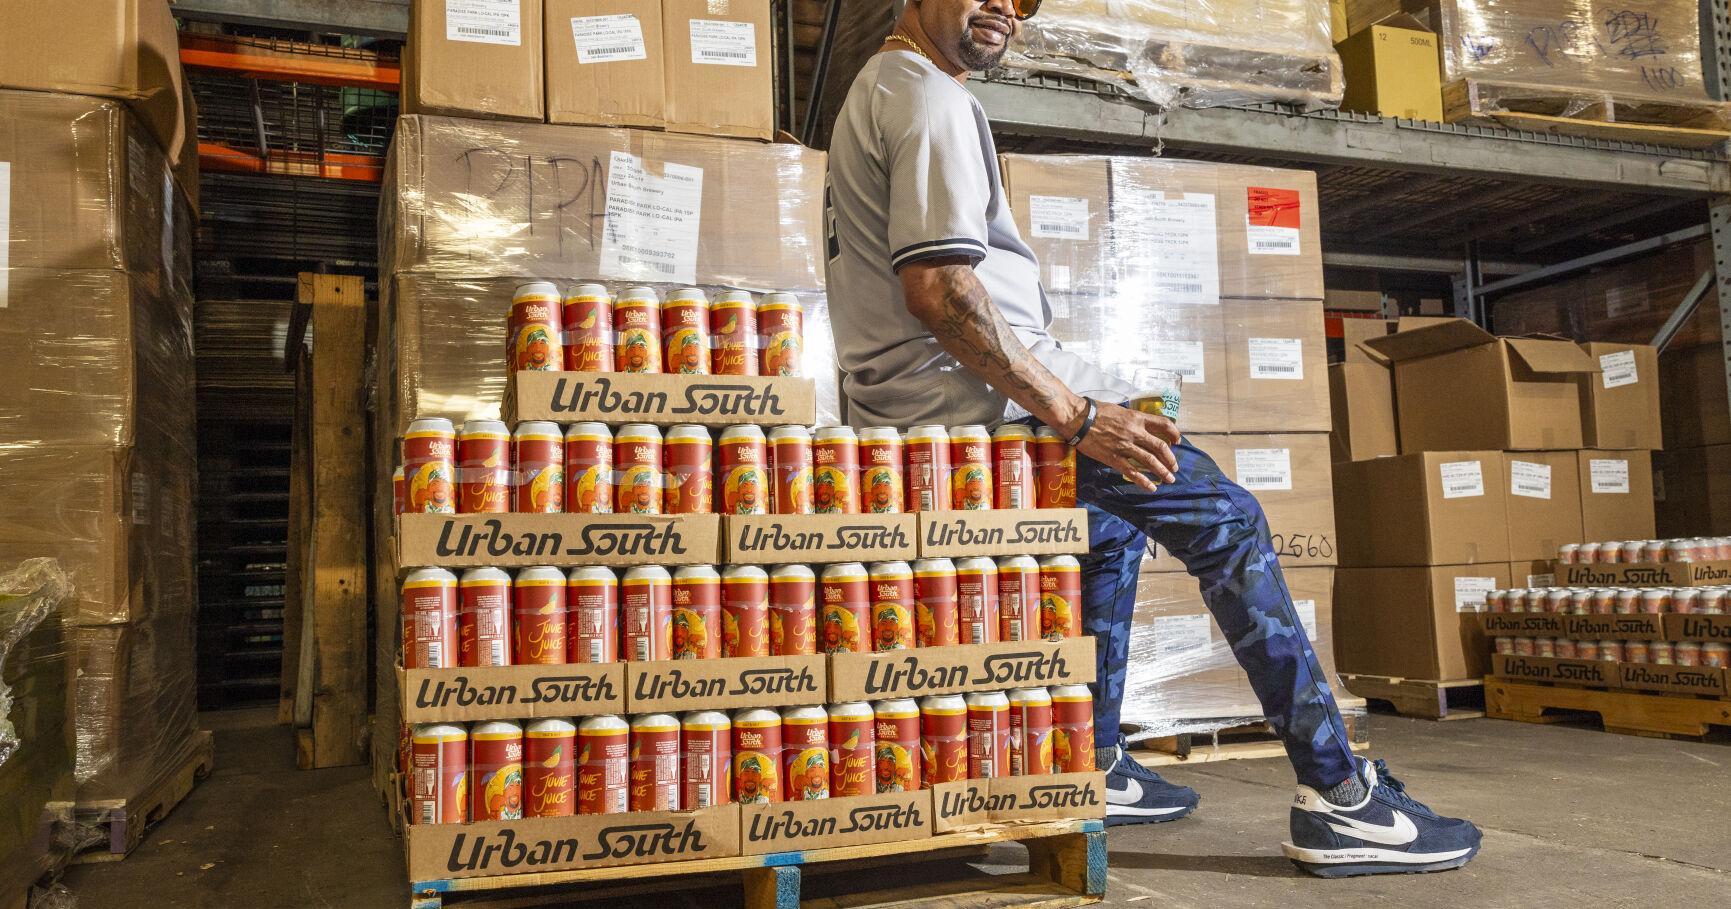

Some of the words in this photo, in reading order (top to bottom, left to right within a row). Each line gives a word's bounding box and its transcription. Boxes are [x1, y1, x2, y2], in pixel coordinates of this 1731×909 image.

[1378, 33, 1387, 41] 12
[1410, 37, 1433, 48] 500ML
[551, 378, 667, 414] Urban
[671, 383, 785, 416] South
[436, 519, 563, 557] Urban
[566, 520, 687, 555] South
[738, 523, 825, 552] Urban
[827, 522, 910, 550] South
[926, 518, 1003, 547] Urban
[1006, 517, 1082, 543] South
[1271, 534, 1332, 558] 2560
[1567, 567, 1616, 584] Urban
[1618, 567, 1673, 583] South
[1694, 566, 1728, 581] Urban
[1486, 617, 1519, 630] Urban
[1521, 617, 1561, 631] South
[1569, 617, 1609, 634] Urban
[1611, 618, 1657, 634] South
[1683, 618, 1731, 638] Urba
[531, 637, 566, 659] JUICE
[634, 669, 726, 701] Urban
[729, 665, 818, 695] South
[865, 656, 968, 695] Urban
[972, 647, 1070, 685] South
[1505, 658, 1551, 679] Urban
[1553, 663, 1605, 683] South
[1625, 667, 1671, 685] Urban
[1672, 668, 1719, 688] South
[416, 676, 517, 708] Urban
[520, 672, 618, 703] South
[834, 754, 869, 775] JUVIE
[532, 772, 572, 797] JUVIE
[836, 768, 870, 791] JUICE
[533, 788, 572, 813] JUICE
[940, 786, 1017, 819] Urban
[1019, 781, 1100, 809] South
[748, 810, 836, 842] Urban
[840, 800, 924, 834] South
[447, 829, 579, 872] Urban
[583, 818, 707, 861] South
